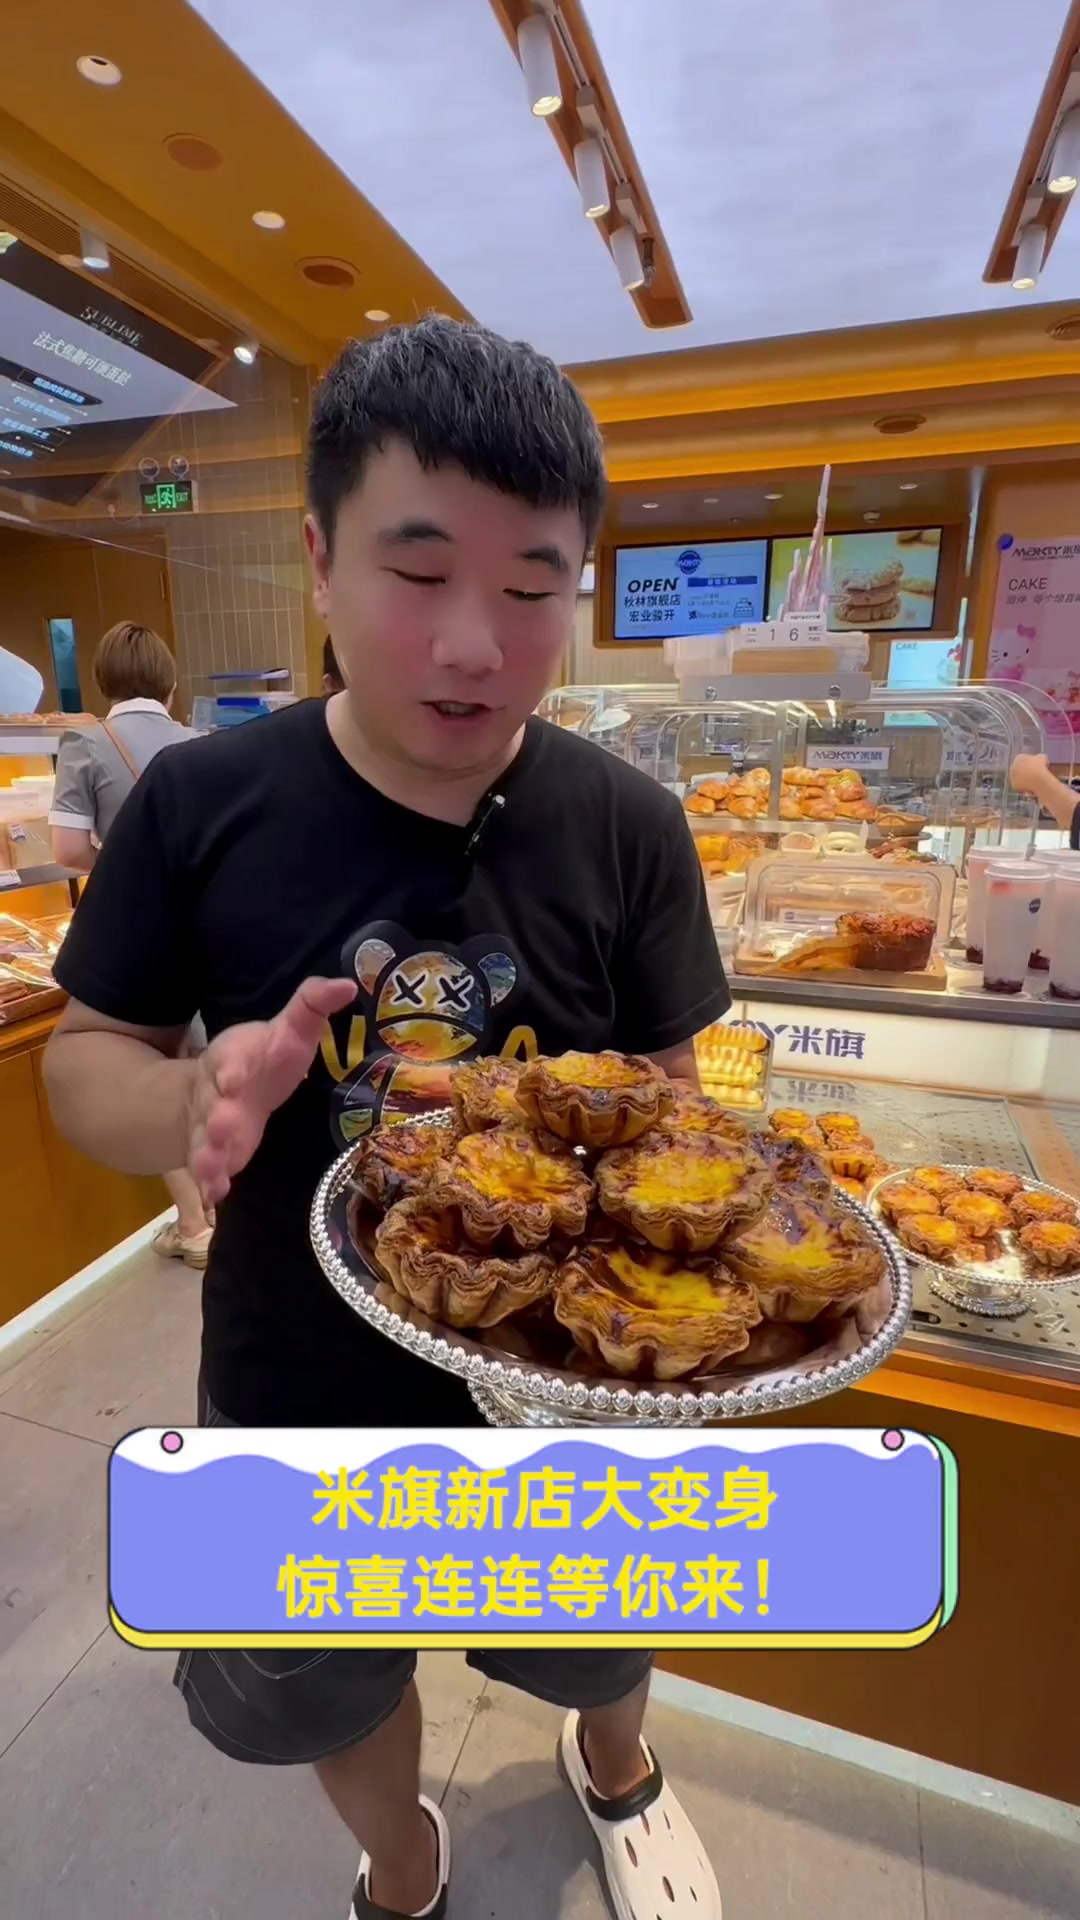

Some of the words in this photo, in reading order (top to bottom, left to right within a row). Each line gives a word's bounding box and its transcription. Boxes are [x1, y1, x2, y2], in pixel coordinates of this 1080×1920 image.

[627, 577, 679, 593] OPEN
[1008, 577, 1048, 591] CAKE
[624, 594, 681, 608] 秋林旗舰店
